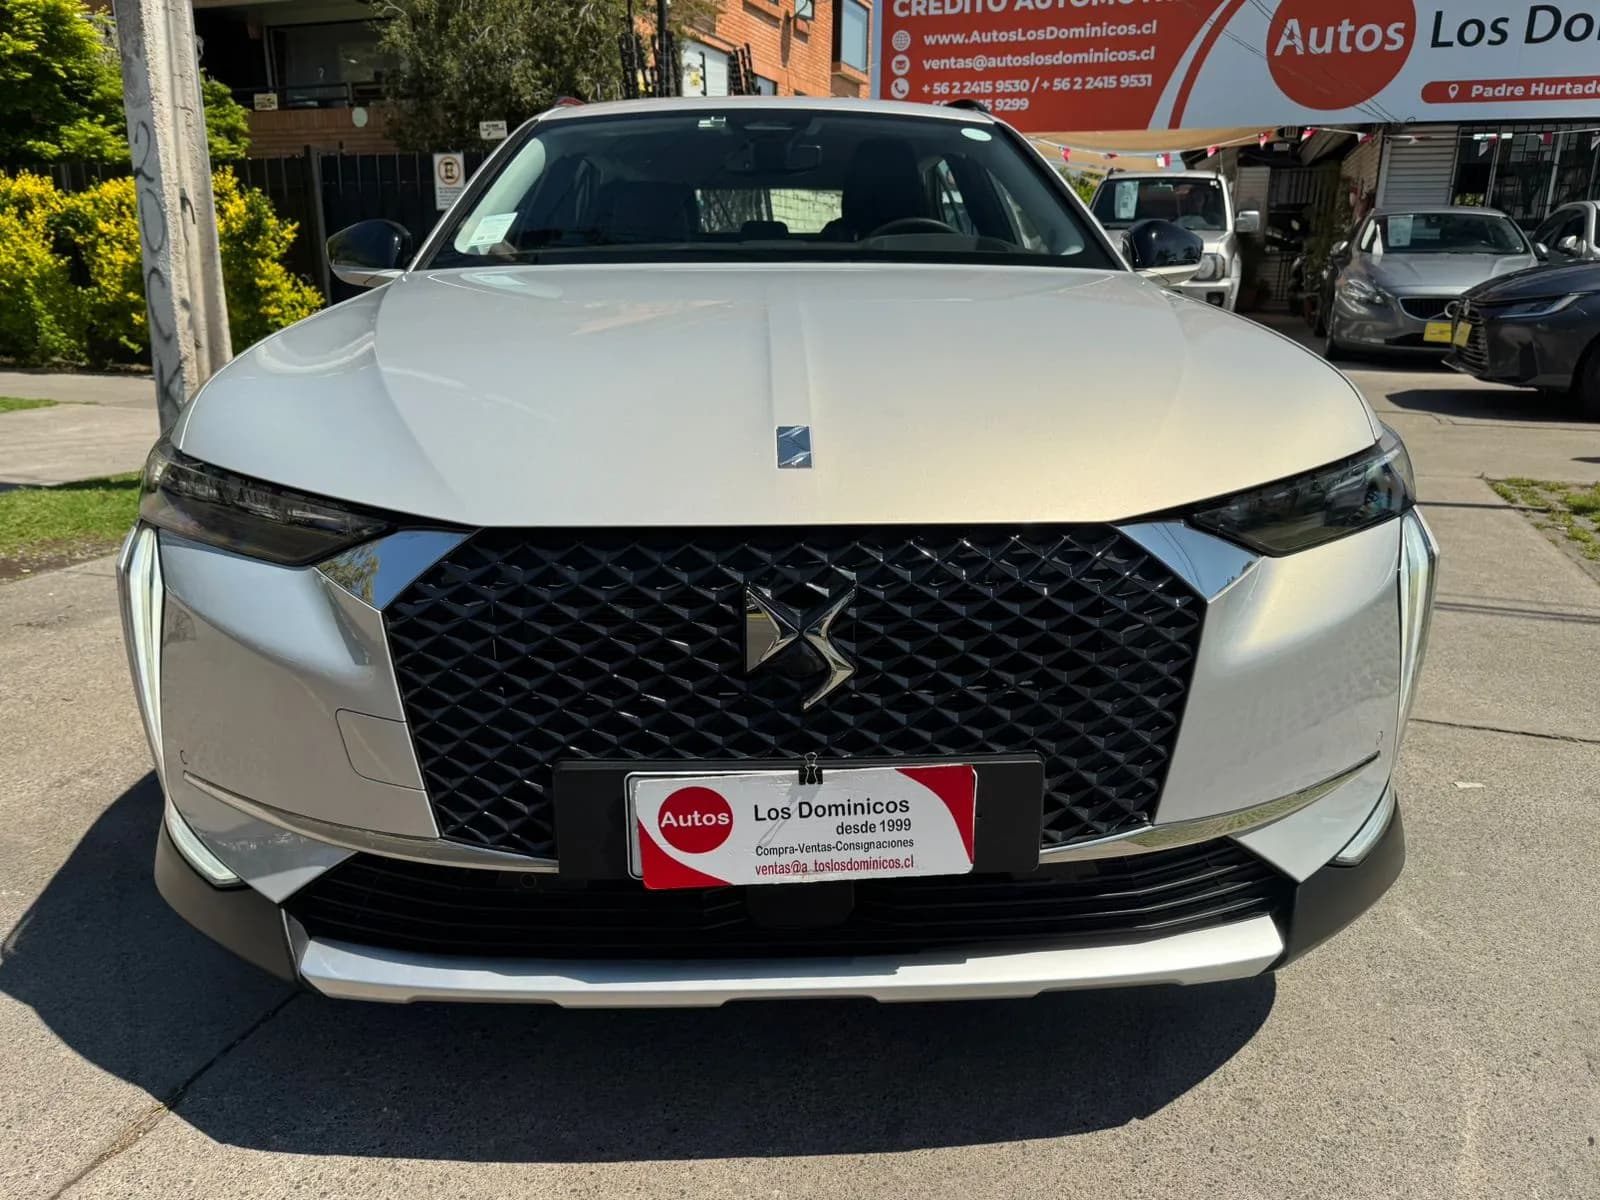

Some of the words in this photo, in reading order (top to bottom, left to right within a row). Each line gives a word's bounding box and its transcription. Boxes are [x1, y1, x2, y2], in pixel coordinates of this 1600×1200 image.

[923, 19, 1157, 46] www.AutosLosDominicos.cl
[1274, 17, 1406, 57] Autos
[1430, 10, 1510, 49] Los
[1524, 4, 1600, 45] Do
[922, 46, 1155, 71] ventas@autoslosdominicos.cl
[963, 80, 993, 94] 2415
[995, 79, 1030, 93] 9530
[1085, 75, 1117, 89] 2415
[1120, 74, 1152, 88] 9531
[1471, 83, 1525, 98] Padre
[995, 98, 1029, 111] 9299
[660, 810, 731, 828] Autos
[754, 804, 792, 821] Los
[799, 798, 911, 818] Dominicos
[835, 820, 877, 836] desde
[880, 817, 912, 833] 1999
[755, 837, 914, 857] Compra-Ventas-Consignaciones
[755, 854, 914, 876] ventas@atoslosdominicos.cl
